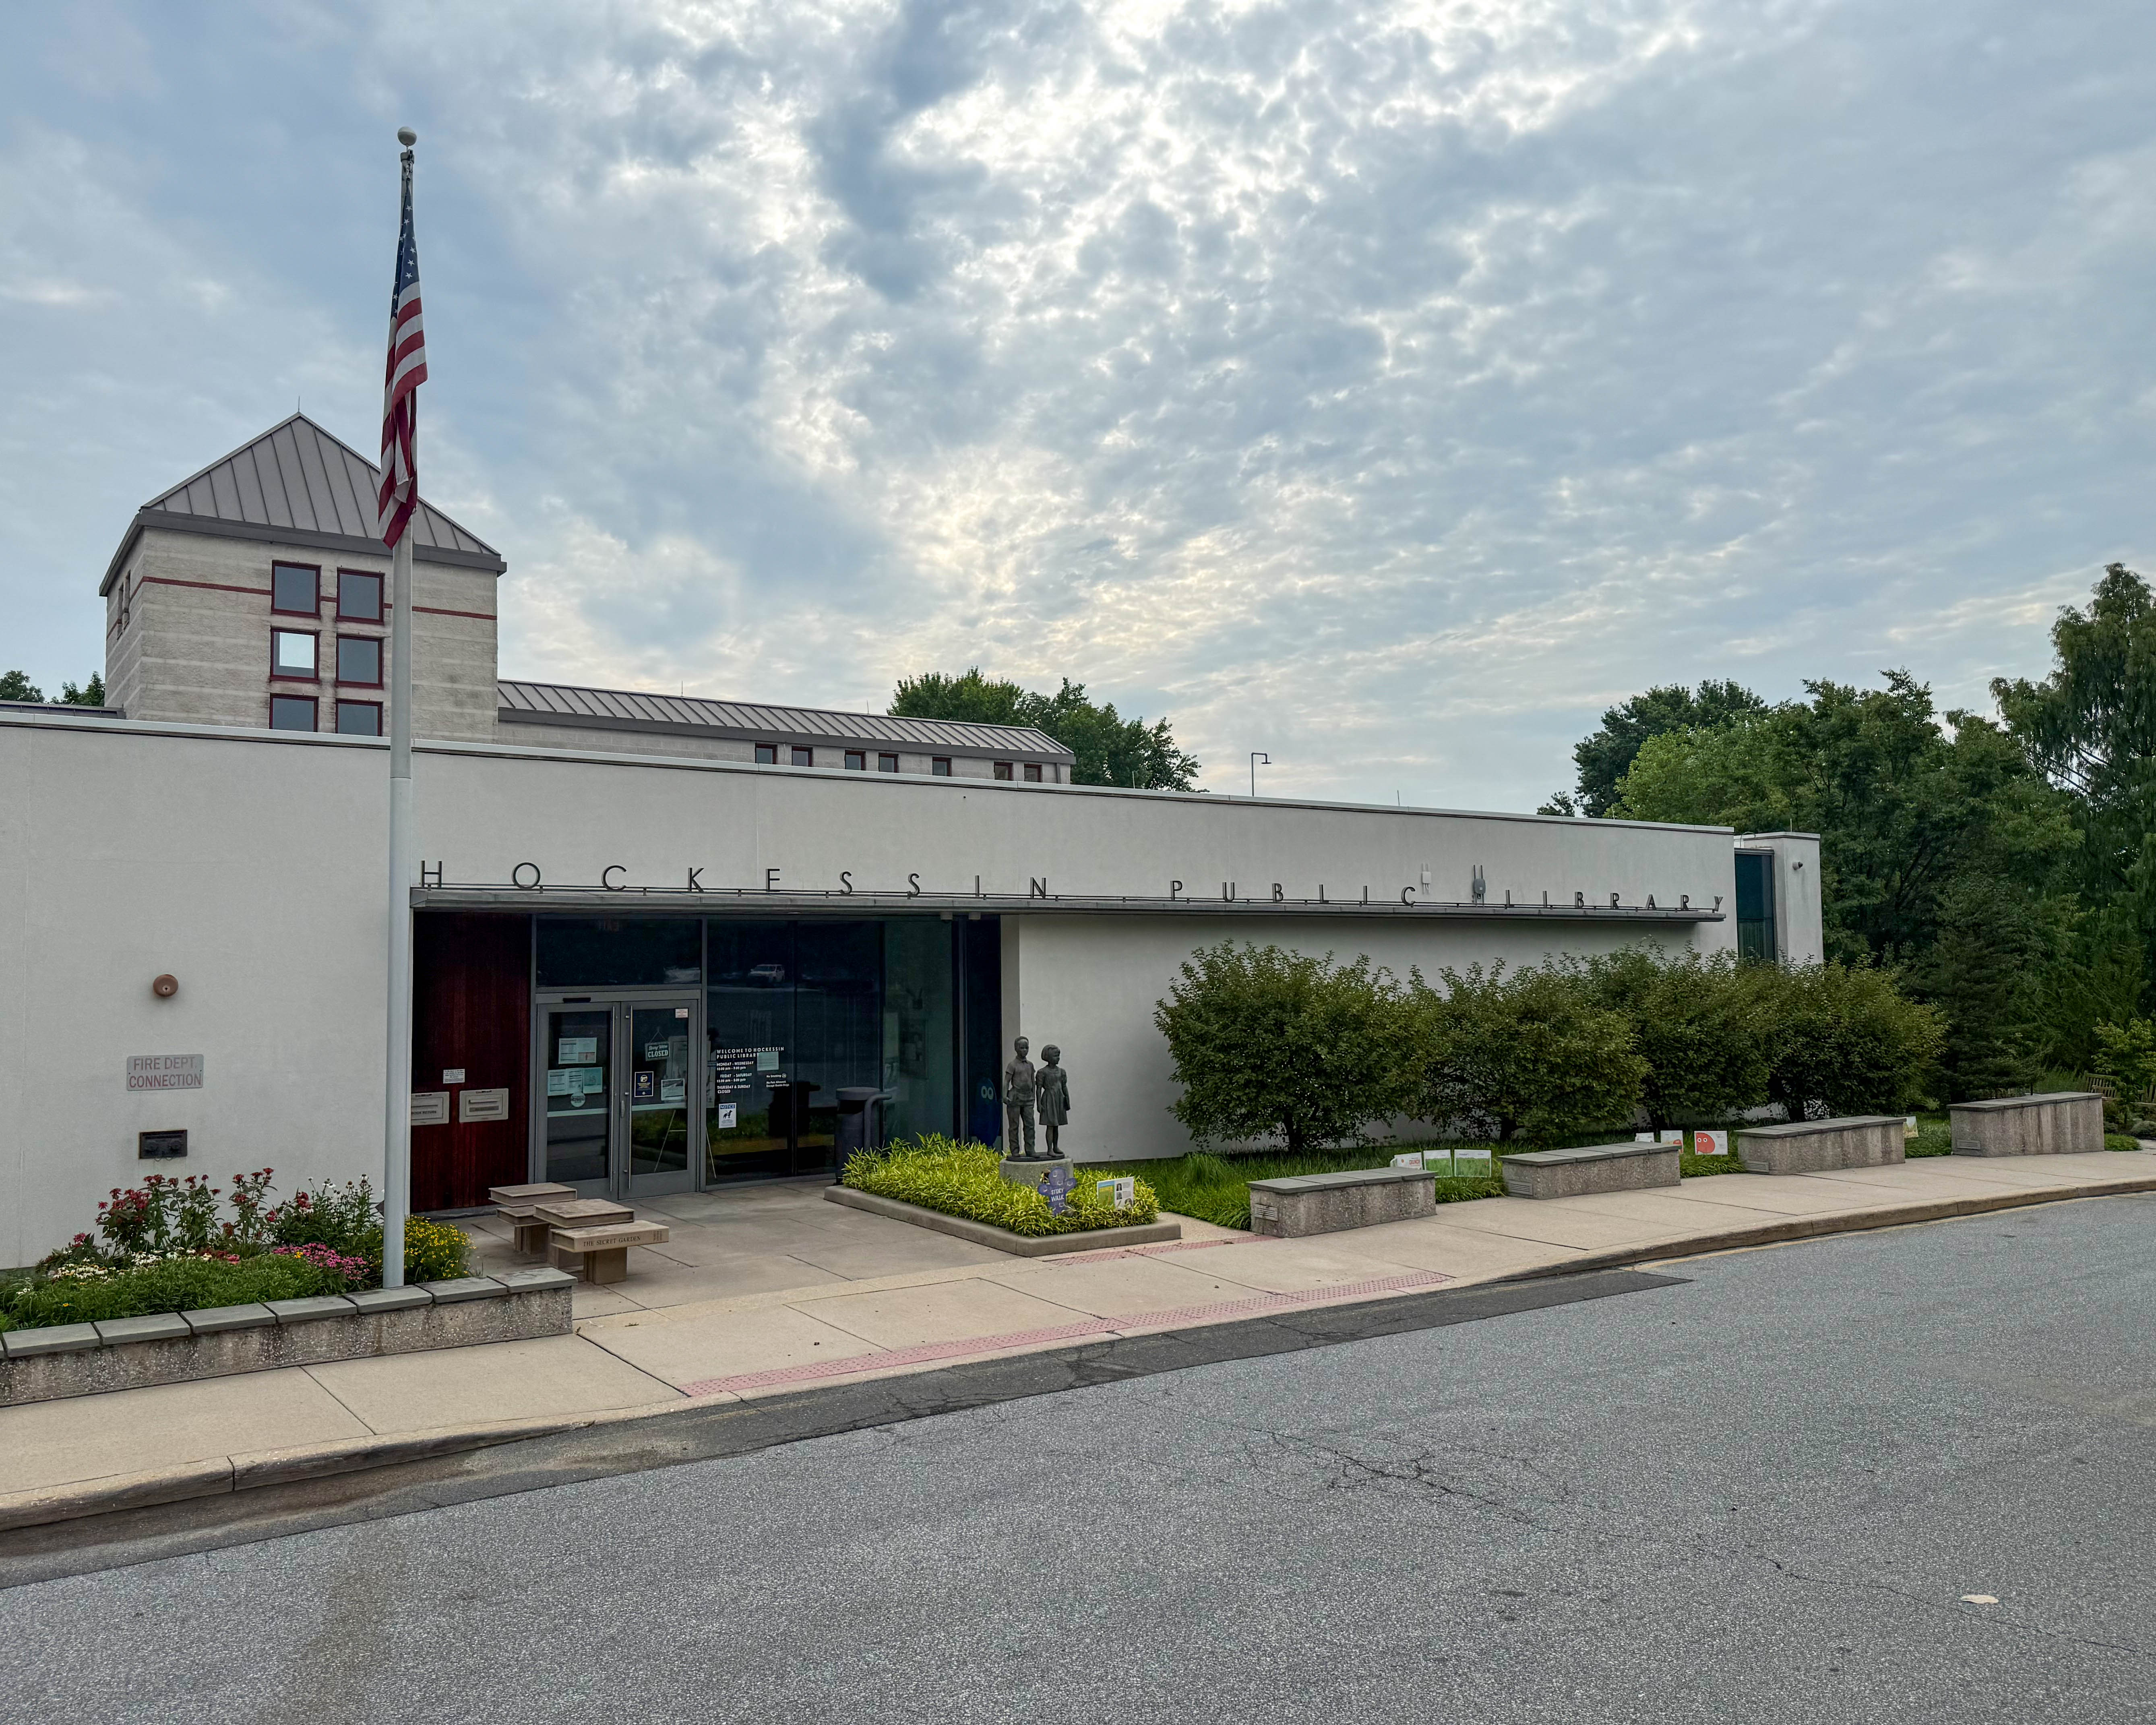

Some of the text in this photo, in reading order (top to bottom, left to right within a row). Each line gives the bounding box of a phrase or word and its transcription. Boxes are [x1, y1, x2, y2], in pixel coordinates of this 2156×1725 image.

[420, 860, 1723, 912] HOCKESSIN PUBLIC LIBRARY
[134, 1056, 196, 1070] FIRE DEPT.
[129, 1073, 201, 1088] CONNECTION
